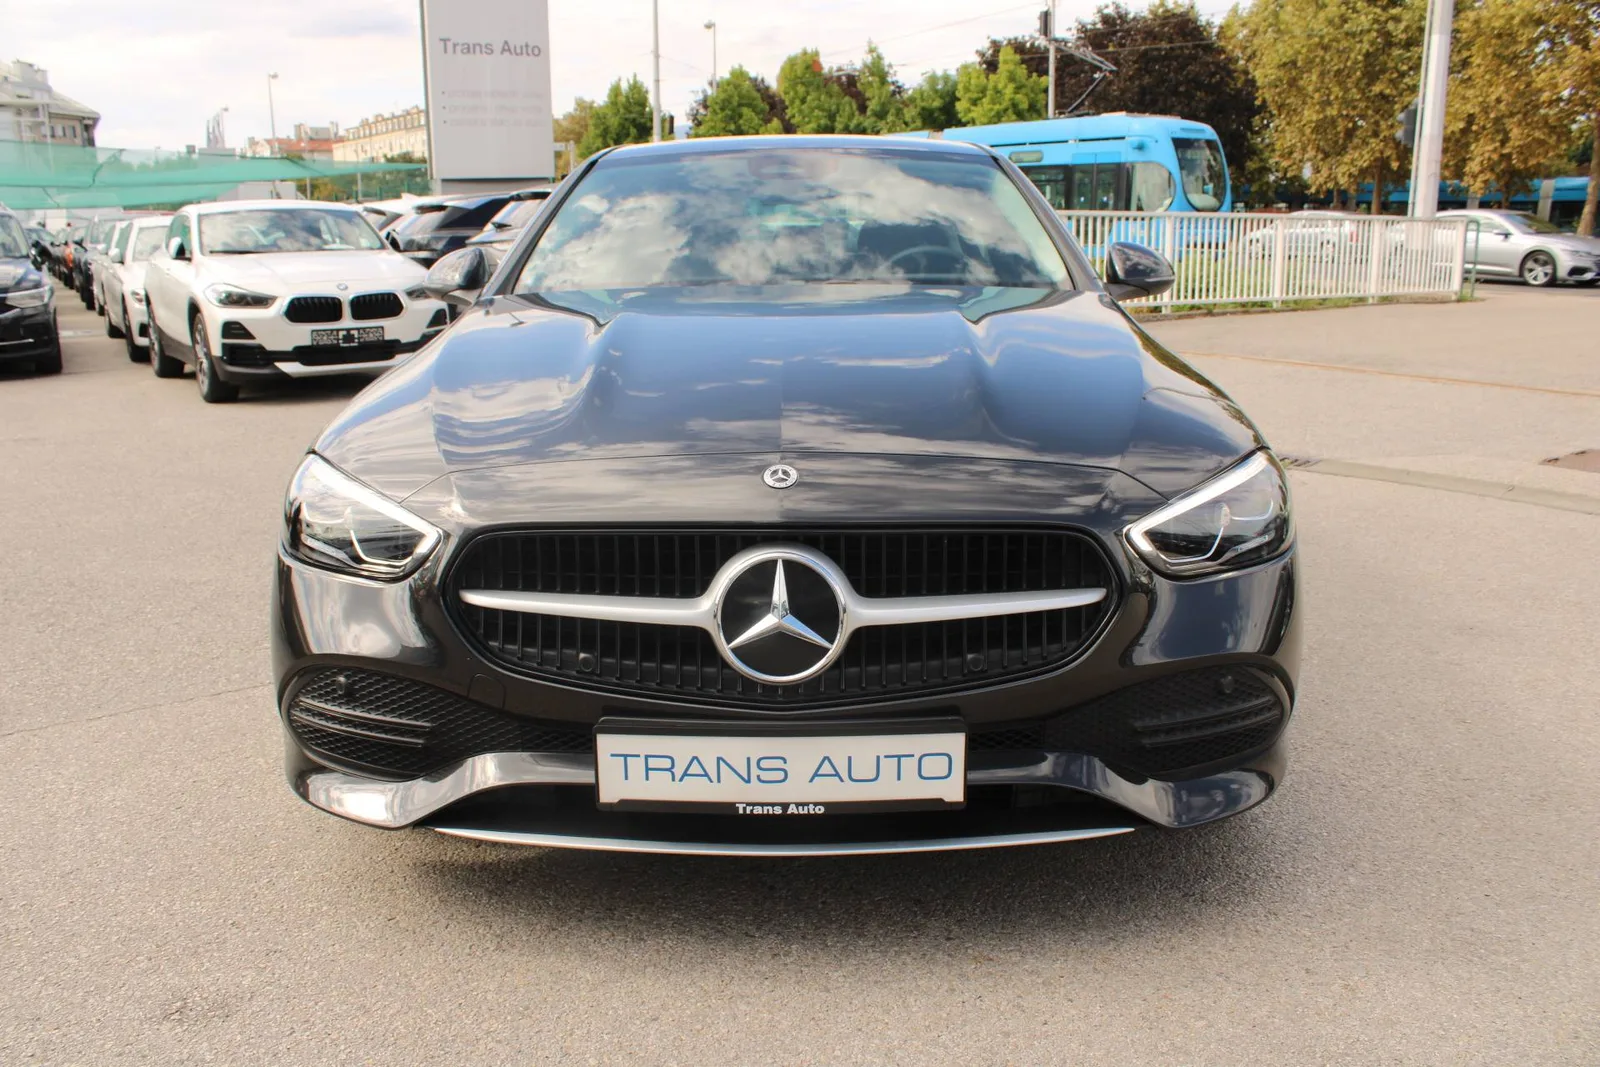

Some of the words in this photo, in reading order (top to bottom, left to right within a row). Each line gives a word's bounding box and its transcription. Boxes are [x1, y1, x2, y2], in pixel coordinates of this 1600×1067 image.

[439, 38, 494, 55] Trans
[500, 40, 542, 57] Auto
[610, 753, 789, 784] TRANS
[808, 752, 953, 783] AUTO
[735, 803, 782, 815] Trans
[787, 803, 825, 815] Auto
